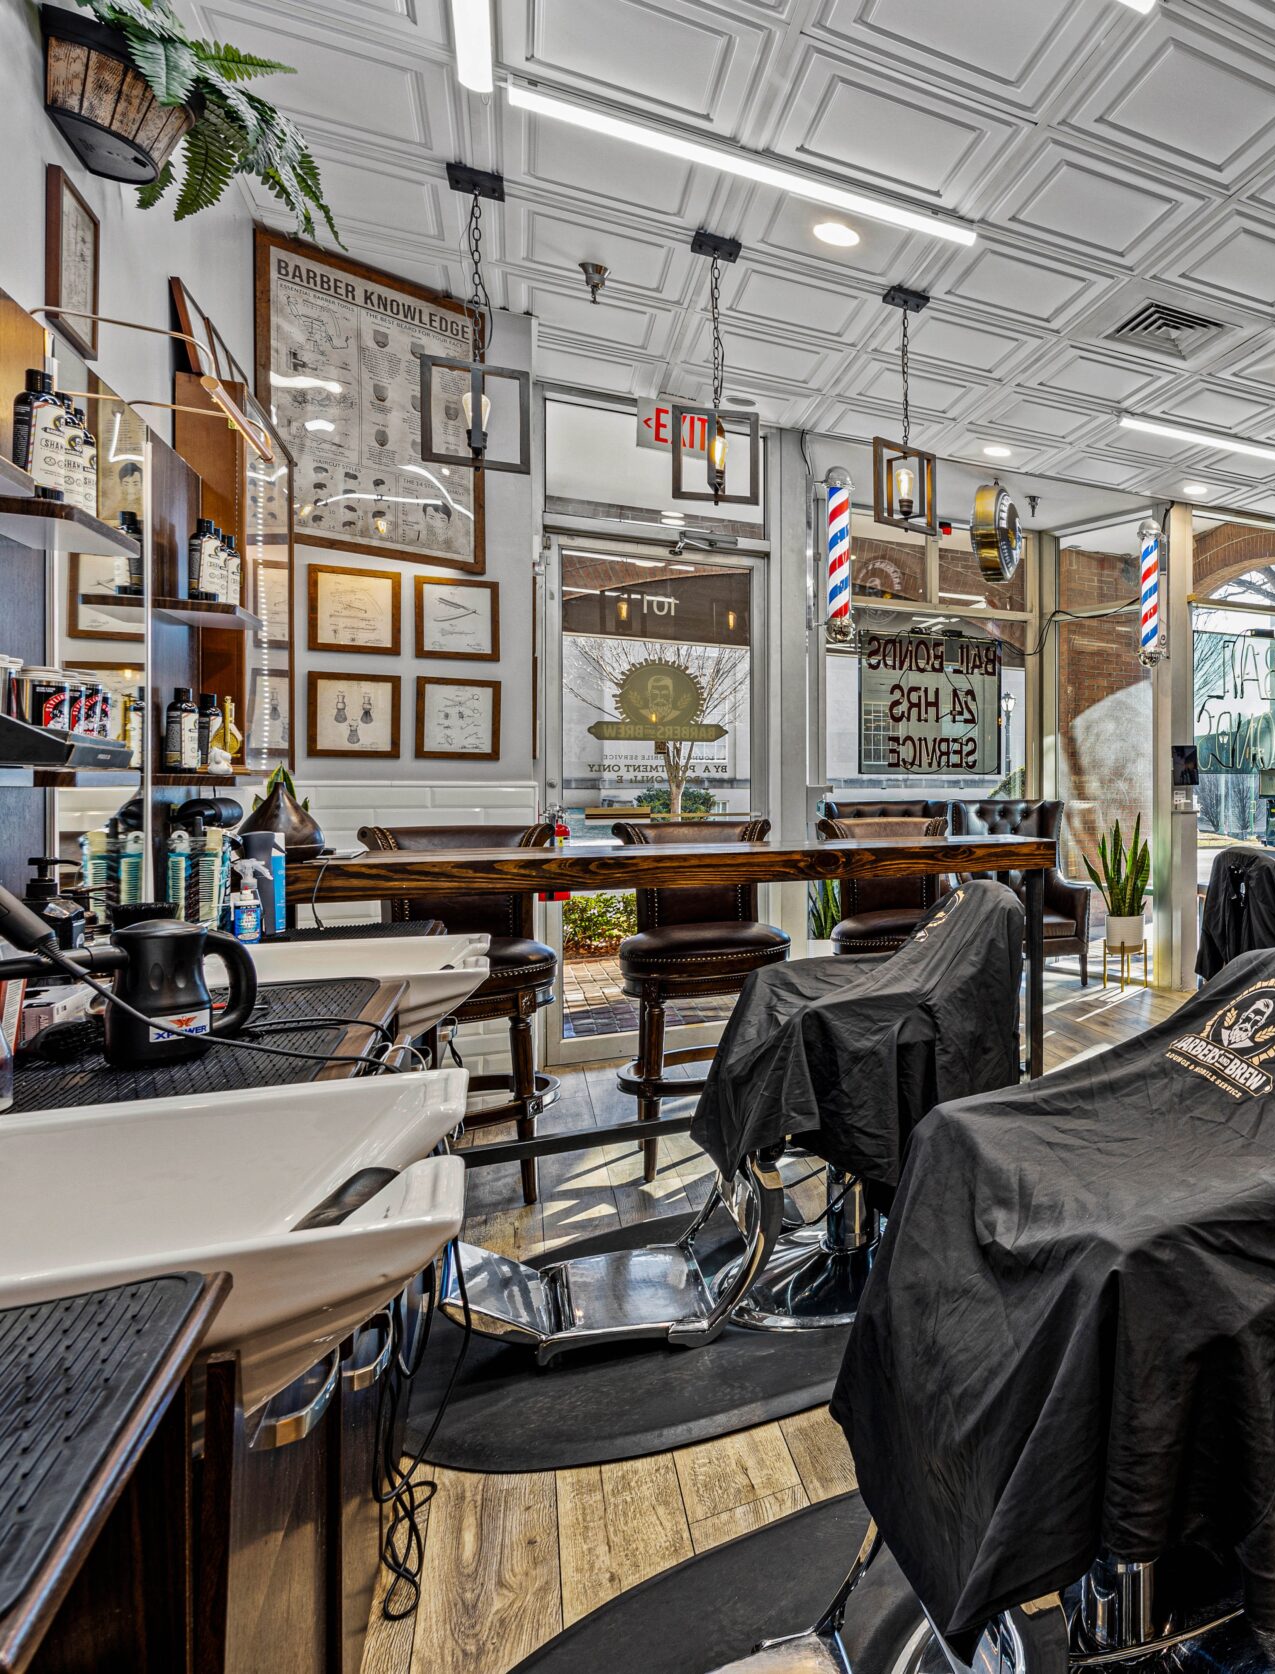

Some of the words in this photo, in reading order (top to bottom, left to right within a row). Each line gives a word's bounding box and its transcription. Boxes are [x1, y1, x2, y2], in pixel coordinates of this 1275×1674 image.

[277, 258, 356, 301] BARBER
[363, 289, 470, 341] KNOWLEDGE
[280, 283, 309, 298] ESSENTIAL
[312, 294, 336, 306] BARBER
[337, 301, 355, 313] TOOLS
[365, 311, 379, 321] THE
[379, 315, 395, 327] BEST
[396, 319, 416, 333] BEARD
[418, 328, 430, 338] FOR
[430, 331, 448, 344] YOUR
[448, 338, 463, 349] FACE
[312, 458, 340, 470] HAIRCUT
[341, 464, 362, 474] STYLES
[403, 478, 415, 486] THE
[153, 1024, 207, 1040] XPWER
[1166, 1052, 1190, 1067] LOUNGE
[1193, 1065, 1216, 1083] MOBILE
[1215, 1078, 1242, 1099] SERVICE
[1218, 1055, 1231, 1067] AND
[1225, 1057, 1267, 1090] BREW
